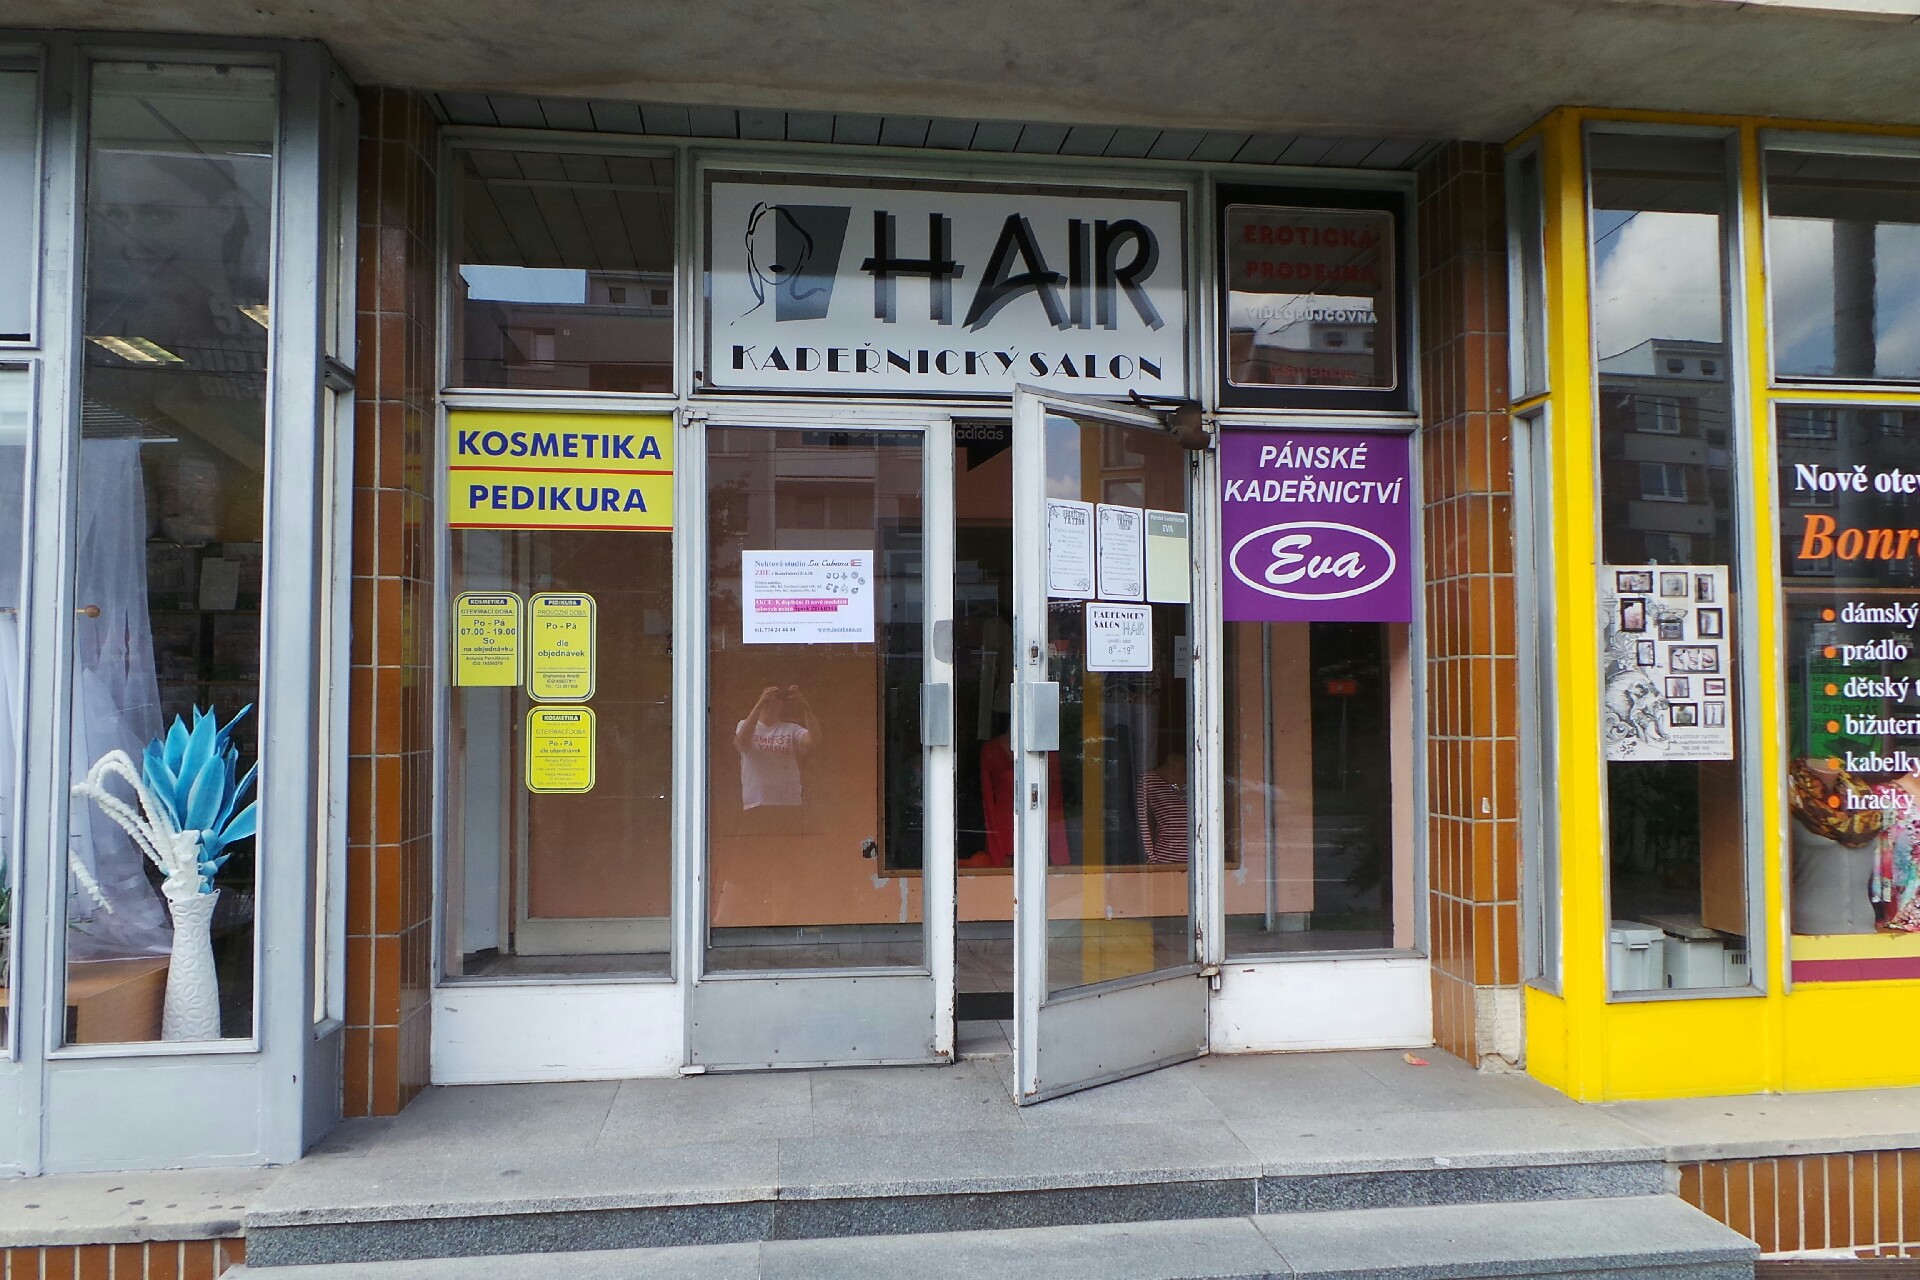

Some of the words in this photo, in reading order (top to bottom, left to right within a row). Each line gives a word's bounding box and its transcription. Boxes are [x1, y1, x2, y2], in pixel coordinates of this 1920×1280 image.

[860, 209, 1165, 333] HAIR
[733, 342, 1019, 376] KADEŘNICKÝ
[1030, 351, 1162, 381] SALON
[458, 430, 662, 460] KOSMETIKA
[956, 428, 1004, 440] adidas
[1259, 441, 1368, 469] PÁNSKÉ
[1224, 475, 1403, 504] KADEŘNICTVÍ
[1794, 464, 1868, 492] Nově
[469, 485, 648, 513] PEDIKURA
[1162, 524, 1174, 533] EVA
[1797, 514, 1920, 560] Bonr
[1265, 534, 1366, 584] Eva
[473, 619, 485, 627] Po
[493, 618, 505, 627] Pá
[546, 622, 557, 630] Po
[565, 621, 577, 630] Pá
[1094, 620, 1120, 628] SALON
[1841, 602, 1919, 628] dámský
[461, 627, 484, 636] 07.00
[493, 627, 516, 636] 19.00
[483, 637, 495, 645] So
[556, 639, 569, 647] dle
[538, 649, 585, 658] objednávek
[1842, 639, 1908, 666] prádlo
[1843, 676, 1909, 703] dětský
[1845, 751, 1920, 778] kabelky
[1847, 788, 1915, 814] hračky
